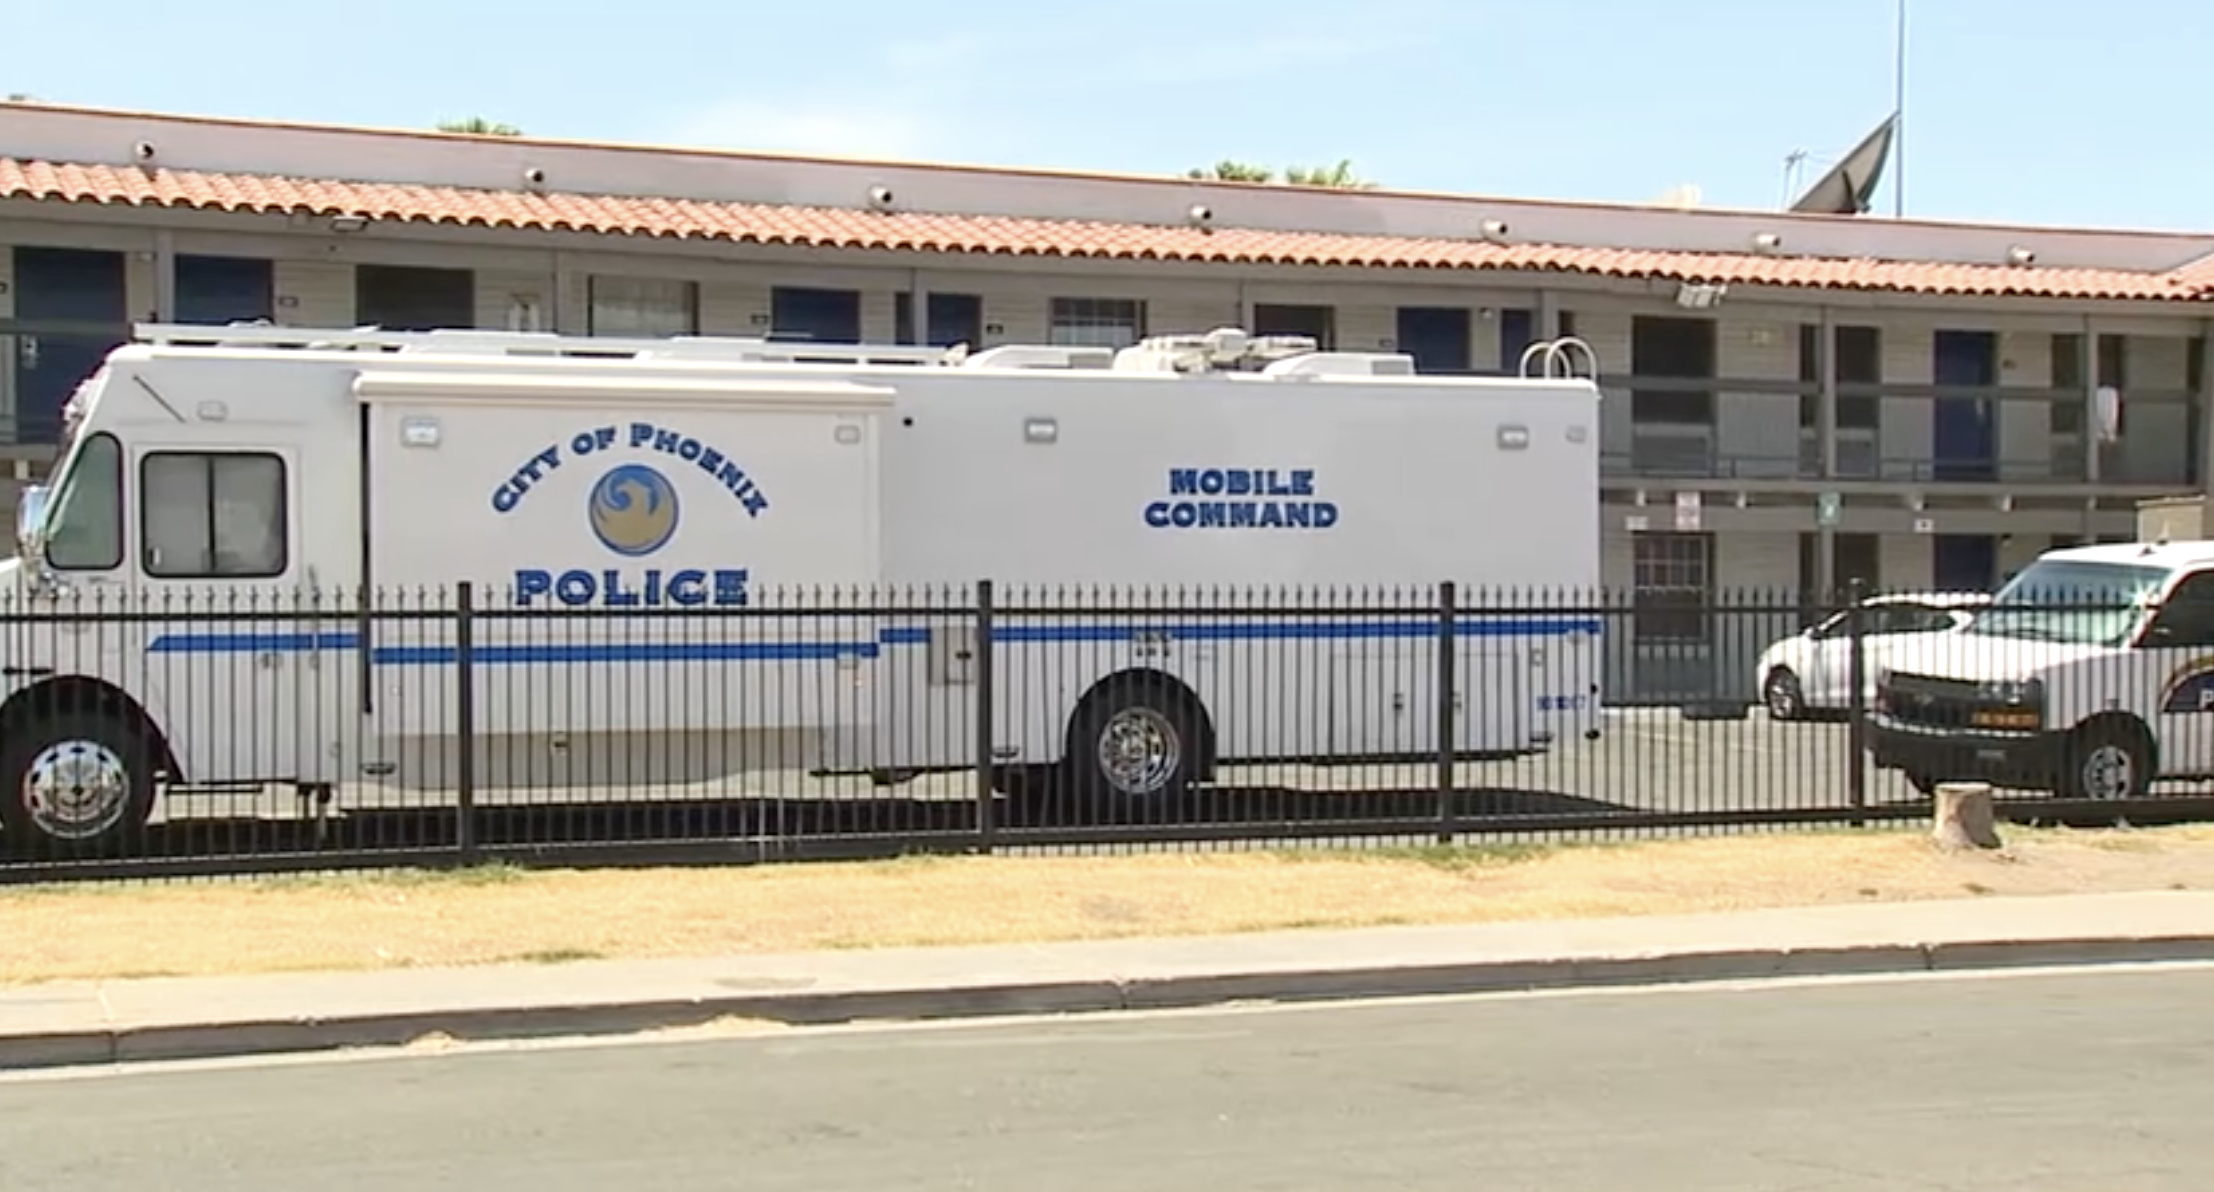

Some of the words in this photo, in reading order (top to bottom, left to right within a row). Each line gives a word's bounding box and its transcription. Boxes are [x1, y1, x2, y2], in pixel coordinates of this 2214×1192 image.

[492, 445, 561, 513] CITY
[571, 426, 616, 455] OF
[629, 422, 769, 518] PHOENIX
[1169, 468, 1314, 496] MOBILE
[1144, 501, 1338, 528] COMMAND
[515, 569, 748, 606] POLICE
